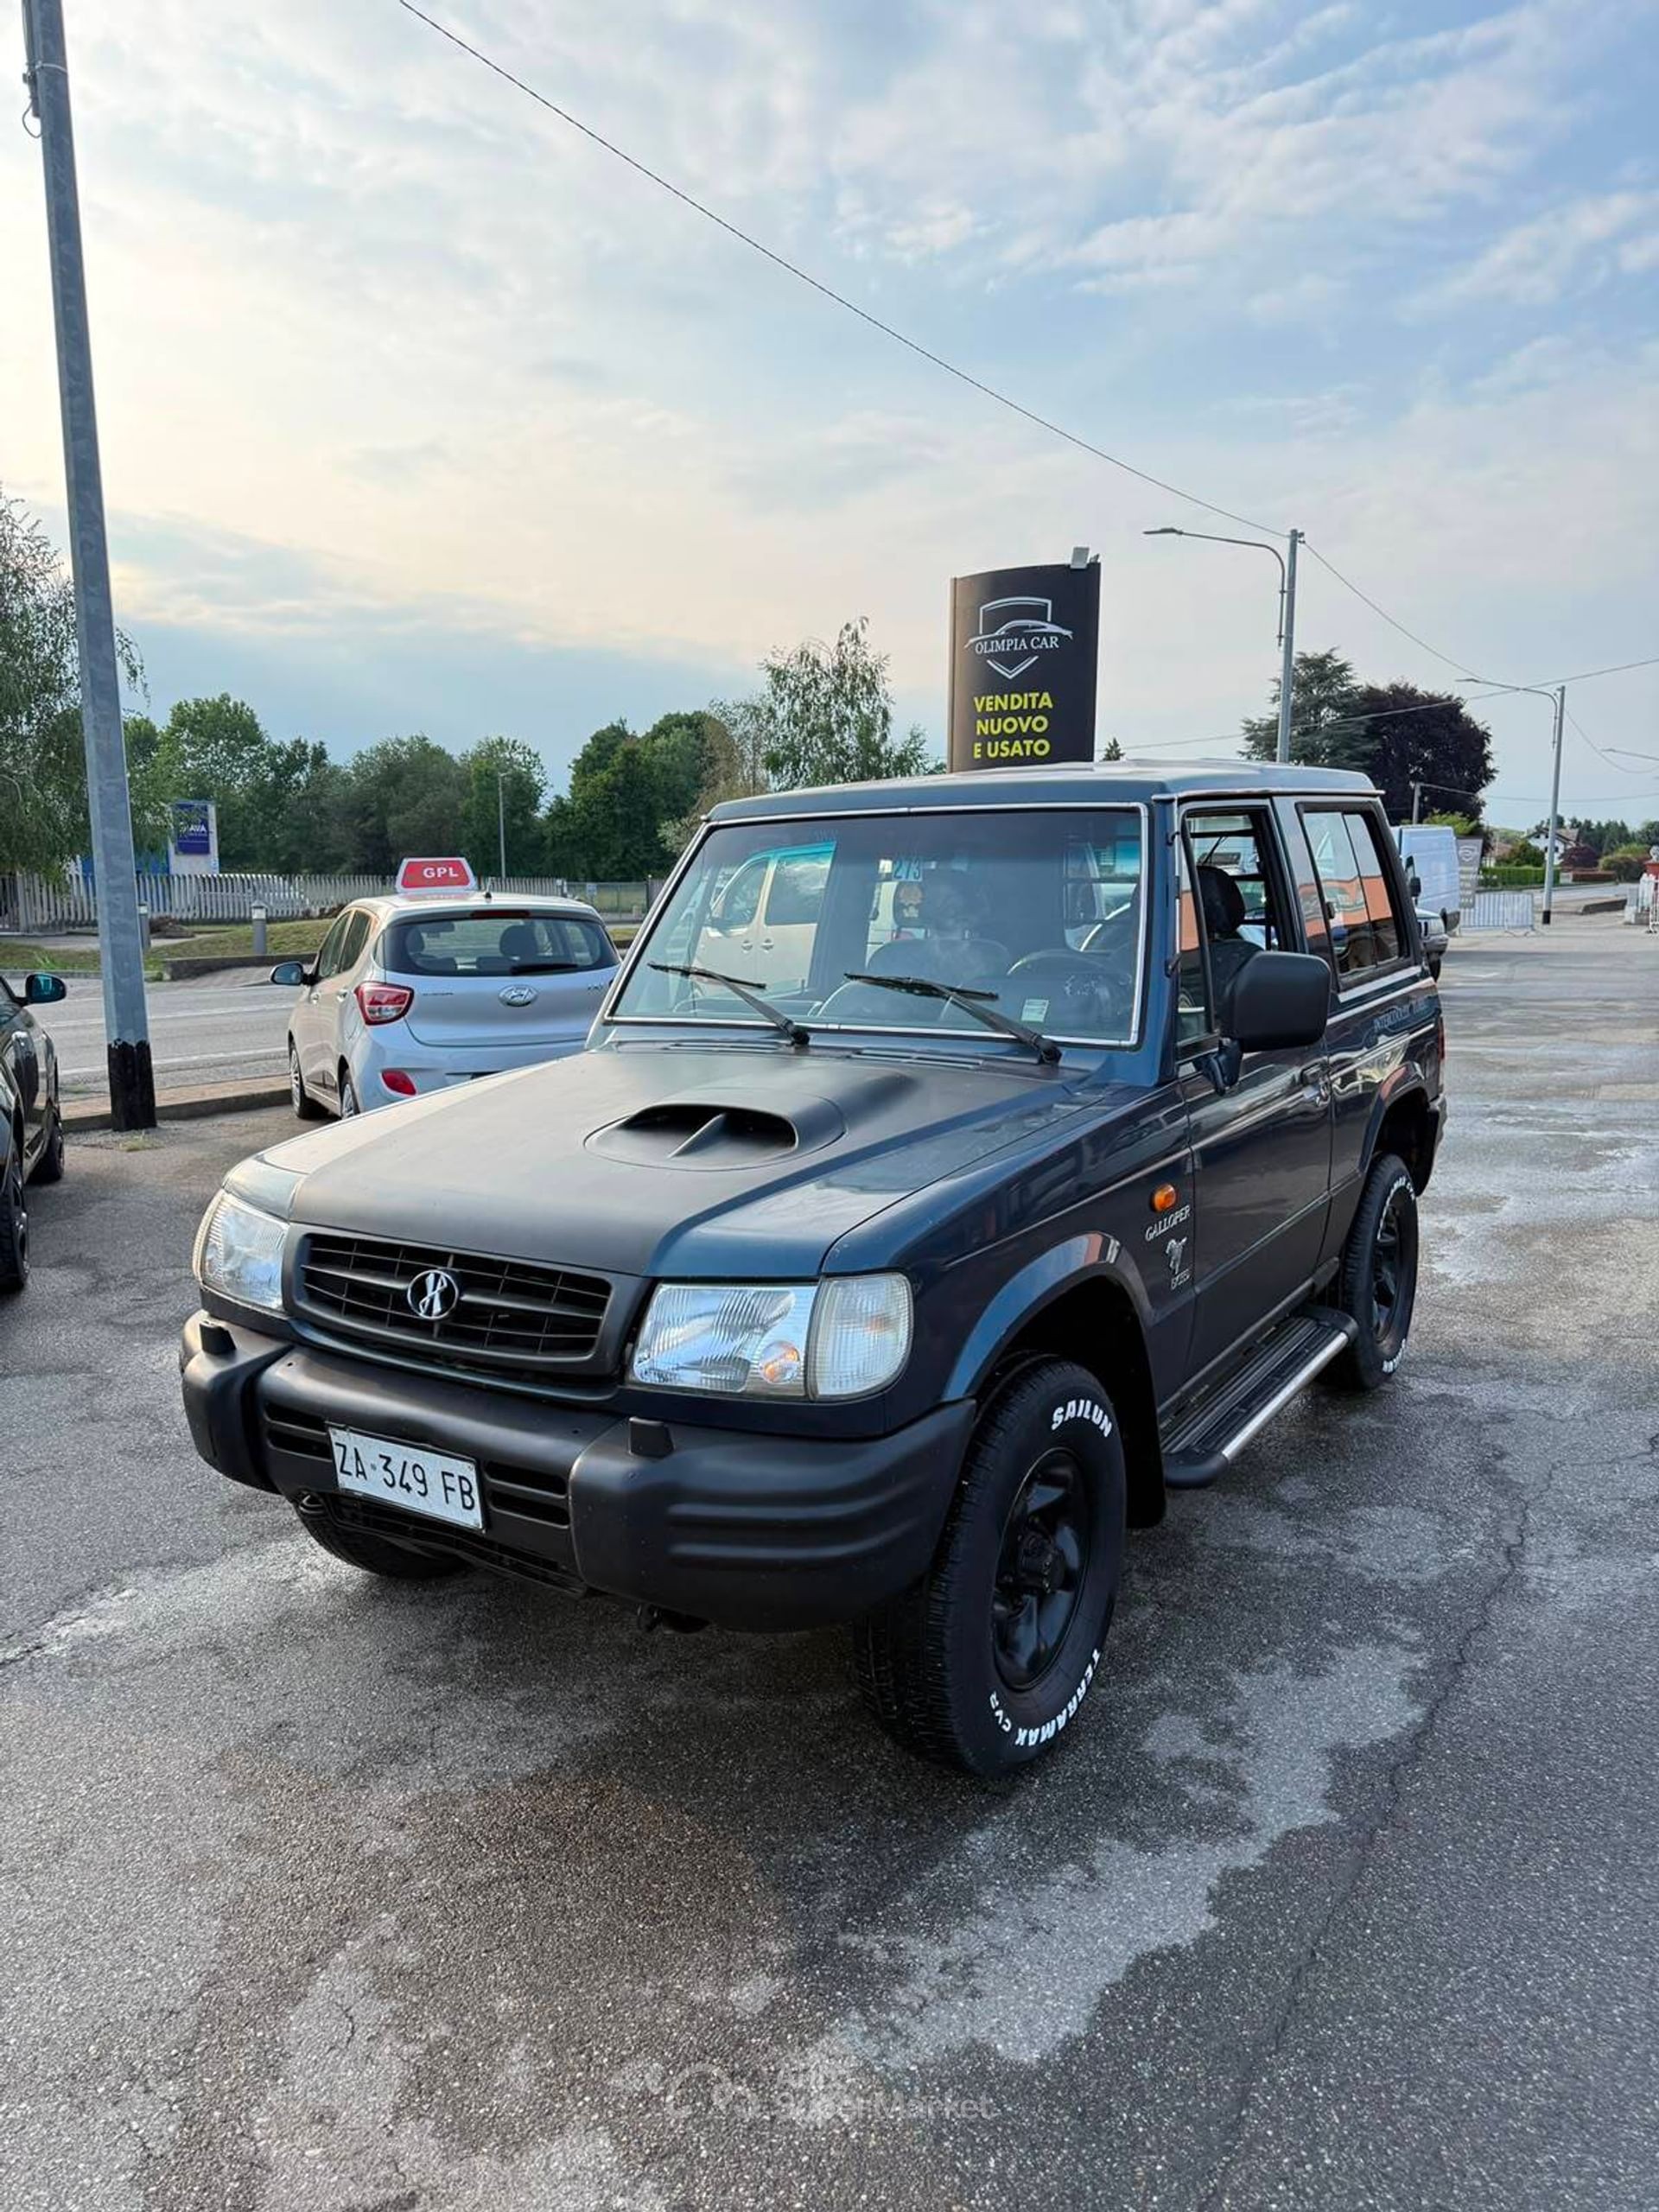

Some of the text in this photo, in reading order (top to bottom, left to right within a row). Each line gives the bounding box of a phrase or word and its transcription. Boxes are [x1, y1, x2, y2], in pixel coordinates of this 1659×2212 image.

[975, 635, 1060, 655] OLIMPIA CAR
[973, 691, 1054, 713] VENDITA
[976, 715, 1049, 735] NUOVO
[973, 740, 1051, 759] E USATO
[423, 867, 459, 879] GPL
[1144, 1204, 1192, 1242] GALLOPER
[1050, 1398, 1113, 1438] SAILUN
[334, 1442, 476, 1511] ZA 349 FB
[1014, 1648, 1101, 1747] TERRAMAX
